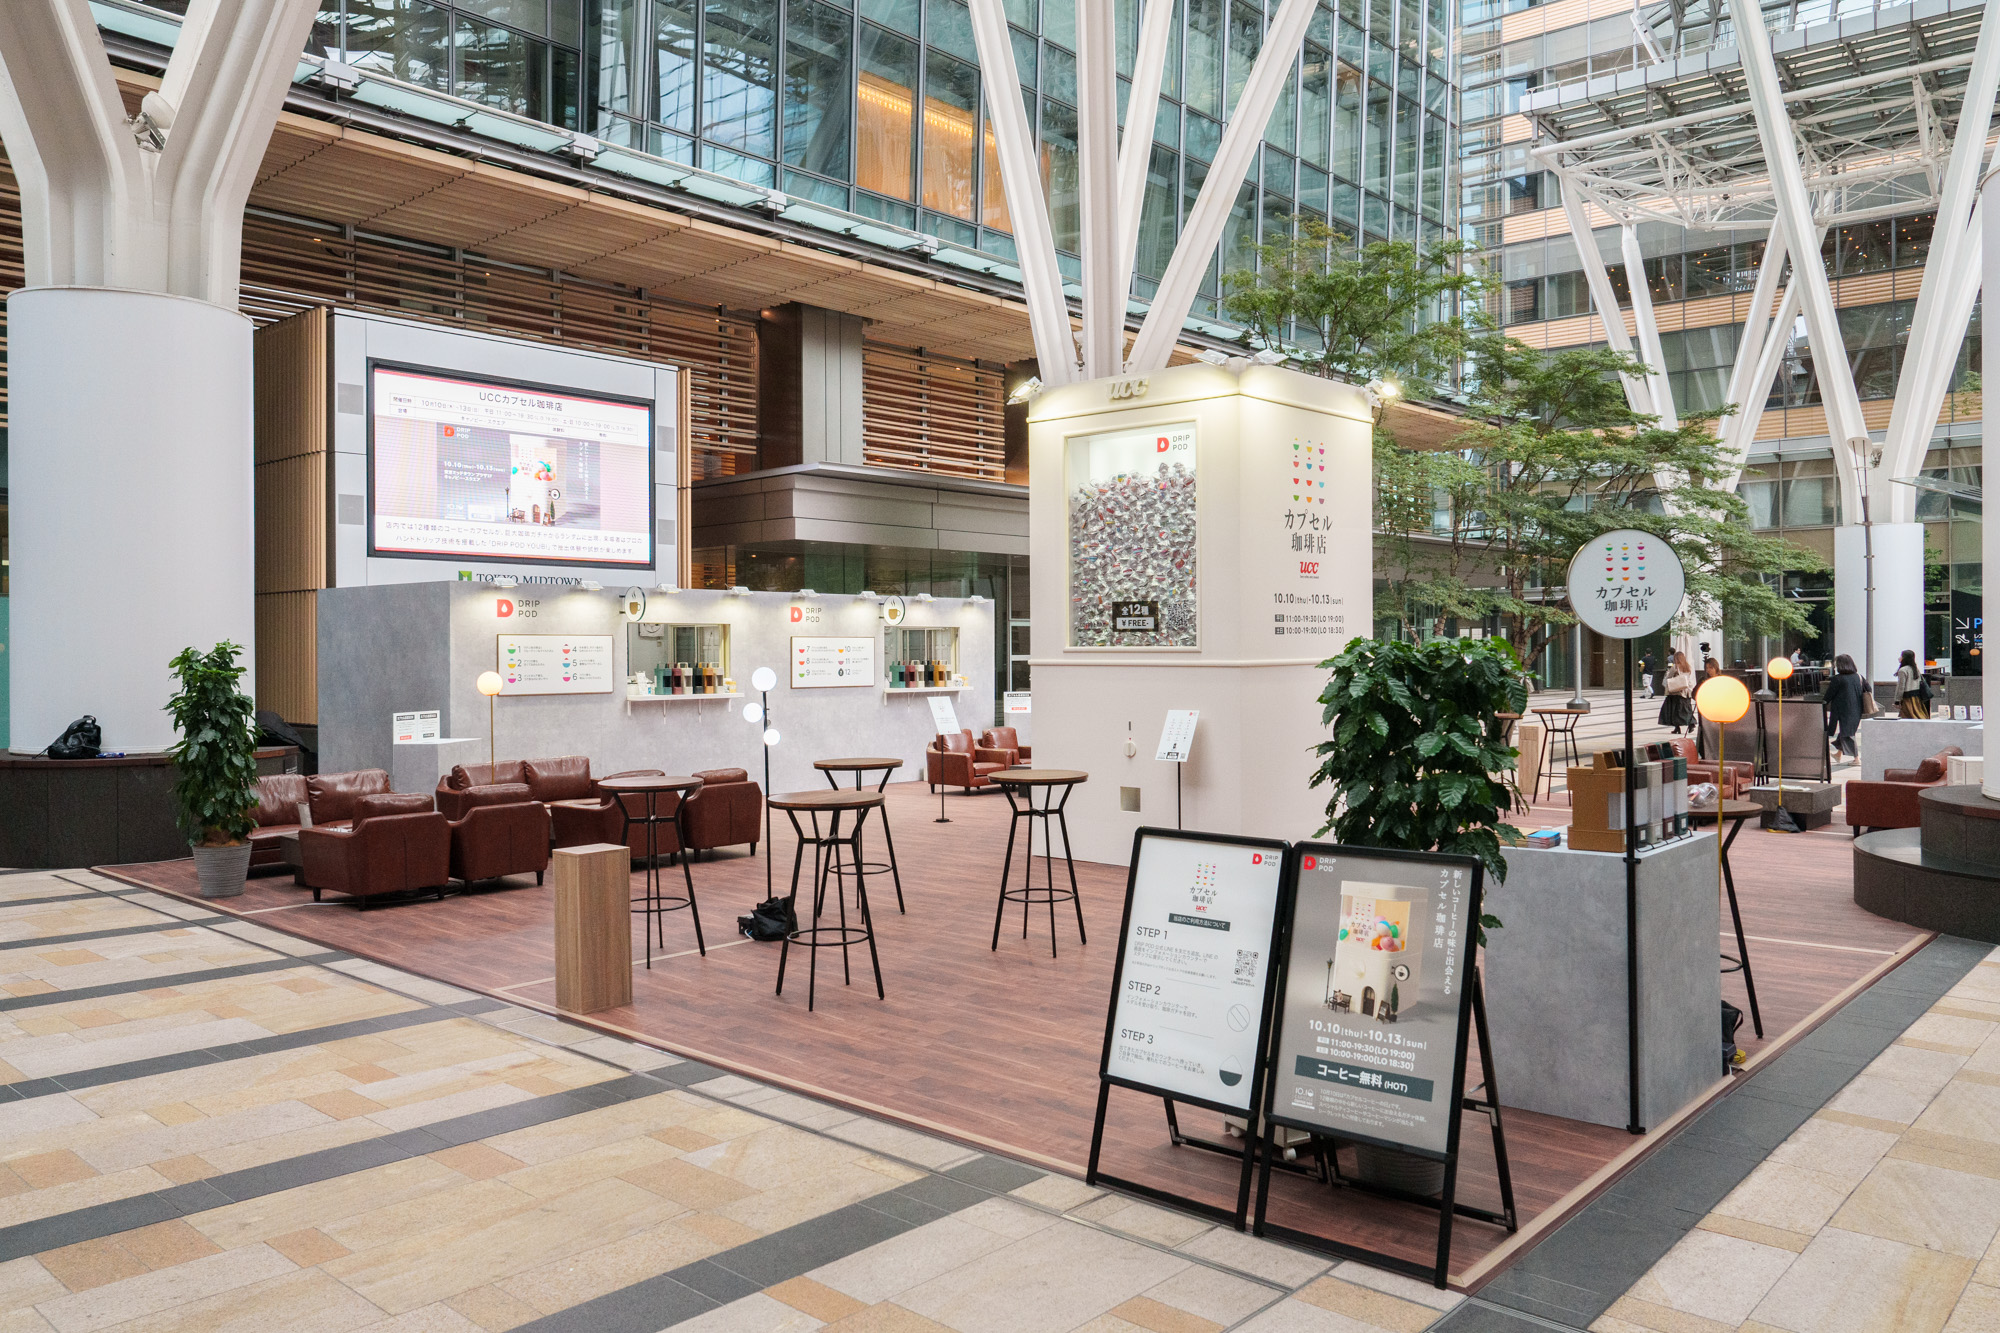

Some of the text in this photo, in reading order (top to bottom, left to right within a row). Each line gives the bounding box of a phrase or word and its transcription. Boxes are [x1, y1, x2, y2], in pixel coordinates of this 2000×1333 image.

[479, 392, 562, 411] UCCカプセル珈琲店
[1172, 434, 1190, 443] DRIP
[1172, 443, 1188, 451] POD
[1284, 508, 1333, 531] カプセル
[1291, 532, 1327, 554] 珈琲店
[522, 575, 582, 585] MIDTOWN
[1596, 585, 1657, 599] カプセル
[1121, 604, 1149, 615] 全12種
[1604, 598, 1648, 612] 珈琲店
[1319, 857, 1337, 865] DRIP
[1190, 886, 1218, 896] カプセル
[1433, 868, 1449, 948] カプセル珈琲店
[1136, 926, 1168, 939] STEP 1
[1444, 869, 1463, 995] 新しいコーヒーの味に出会える
[1128, 980, 1161, 995] STEP 2
[1121, 1028, 1154, 1044] STEP 3
[1390, 1048, 1416, 1061] 19:00)
[1389, 1058, 1414, 1071] 18:30)
[1317, 1063, 1408, 1093] コーヒー無料 (HOT)
